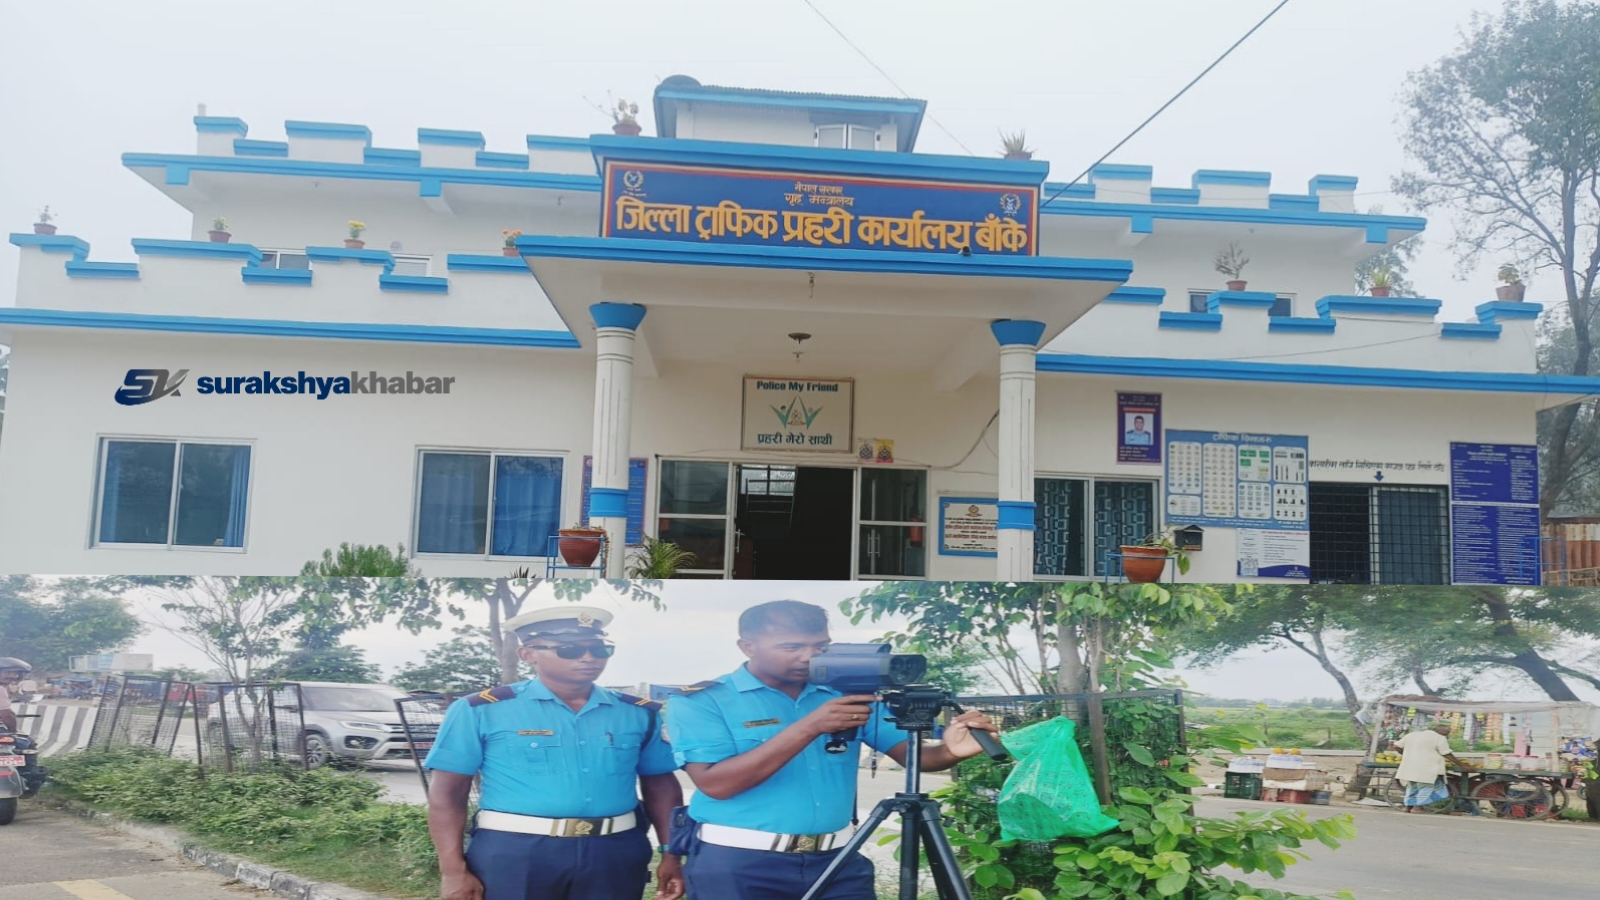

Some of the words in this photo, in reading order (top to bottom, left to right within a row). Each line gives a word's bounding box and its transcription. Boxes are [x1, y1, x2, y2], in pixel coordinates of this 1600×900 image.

[794, 181, 817, 195] नेपाल
[784, 193, 803, 206] गृह
[808, 195, 854, 207] मन्त्रालय
[616, 198, 691, 233] जिल्ला
[694, 200, 780, 240] ट्राफिक
[782, 205, 855, 245] प्रहरी
[859, 210, 974, 250] कार्यालय
[975, 212, 1028, 252] बाँके
[757, 381, 786, 390] Police
[788, 381, 803, 392] My
[806, 382, 838, 392] Friend
[757, 432, 783, 444] प्रहरी
[785, 432, 805, 445] मेरो
[808, 433, 833, 445] साथी
